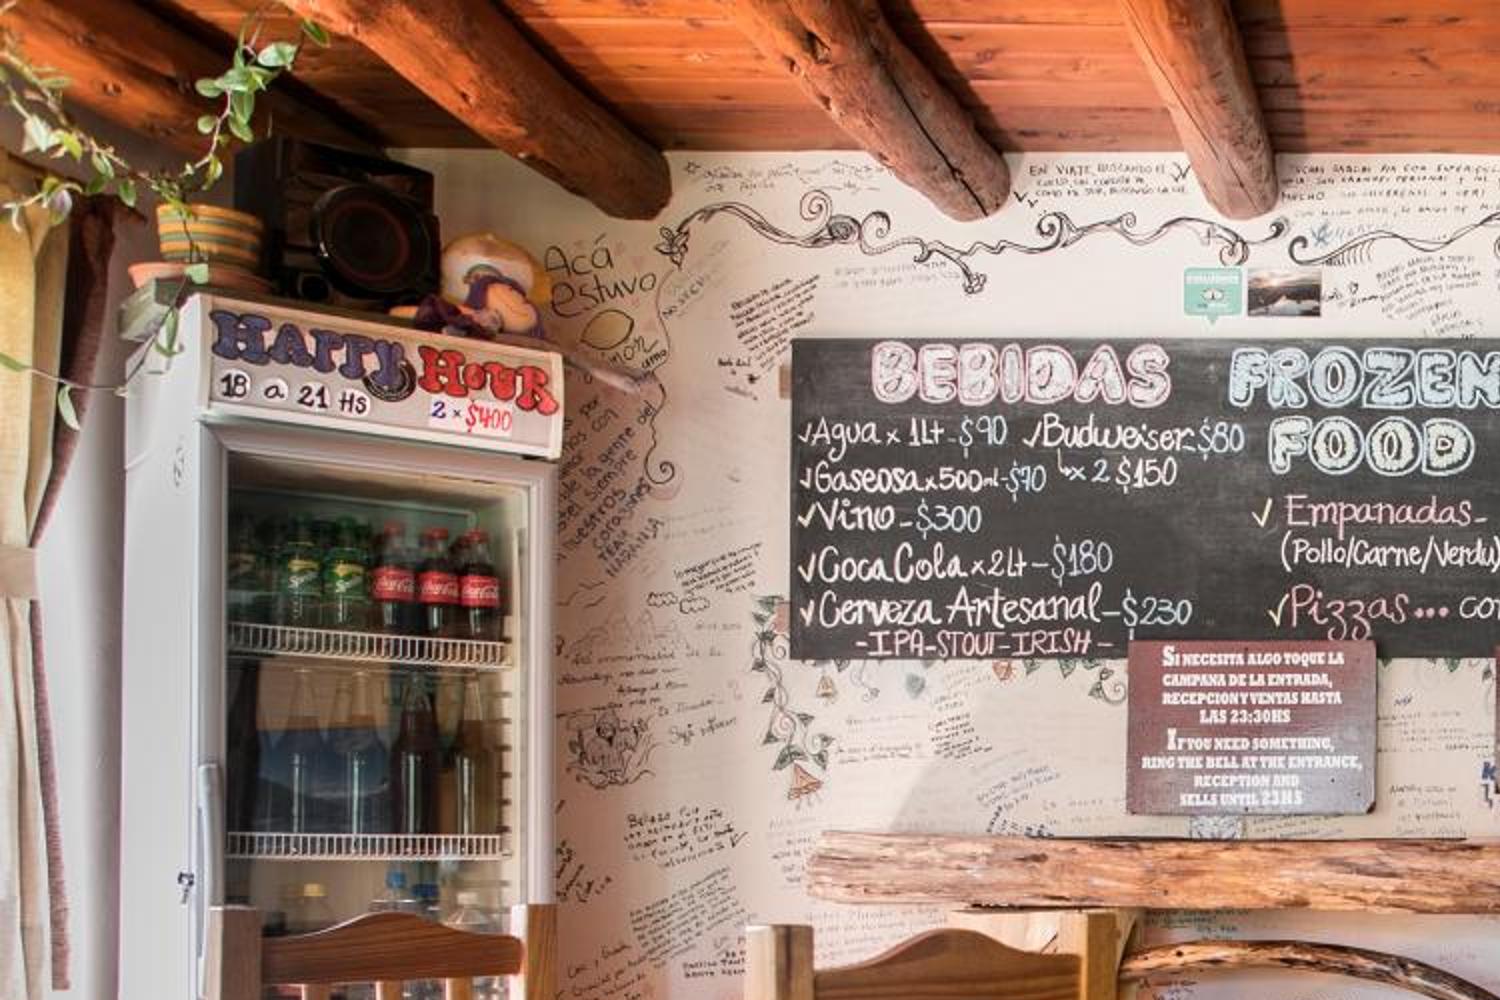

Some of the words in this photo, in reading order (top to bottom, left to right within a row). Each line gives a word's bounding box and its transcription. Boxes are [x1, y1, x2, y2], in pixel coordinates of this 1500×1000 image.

[209, 308, 407, 389] HAPPY
[417, 345, 560, 417] HOUR
[871, 341, 1172, 407] BEBIDAS
[219, 371, 248, 399] 18
[263, 383, 286, 400] a
[298, 384, 330, 409] 21
[431, 400, 447, 420] 2
[464, 397, 514, 433] $400
[812, 417, 883, 462] Agua
[958, 415, 1008, 459] $90
[1040, 412, 1184, 453] Budweiser
[1196, 416, 1246, 461] $80
[1267, 414, 1477, 477] FOOD
[814, 461, 924, 494] Gaseosa
[1094, 459, 1112, 483] 2
[1114, 455, 1178, 494] $150
[813, 499, 896, 533] Vino
[915, 497, 983, 540] $300
[1285, 494, 1473, 541] Empanadas
[818, 546, 894, 584] Coca
[894, 541, 970, 583] Cola
[1050, 534, 1114, 588] $180
[818, 590, 943, 631] Cerveza
[946, 581, 1102, 631] Artesanal
[1121, 587, 1193, 641] $230
[1183, 652, 1246, 667] NECESITA
[1247, 652, 1282, 667] ALGO
[1283, 652, 1326, 668] TOQUE
[1327, 651, 1345, 666] LA
[1161, 692, 1238, 706] RECEPCION
[1250, 692, 1299, 706] VENTAS
[1300, 691, 1344, 706] HASTA
[1162, 673, 1228, 688] CAMPANA
[1228, 673, 1248, 687] DE
[1248, 673, 1267, 687] LA
[1199, 709, 1228, 725] LAS
[1142, 756, 1176, 770] RING
[1176, 756, 1204, 770] THE
[1205, 756, 1239, 770] BELL
[1241, 756, 1261, 770] AT
[1260, 756, 1287, 770] THE
[1213, 737, 1251, 751] NEED
[1193, 774, 1270, 788] RECEPTION
[1271, 774, 1301, 788] AND
[1219, 792, 1260, 807] UNTIL
